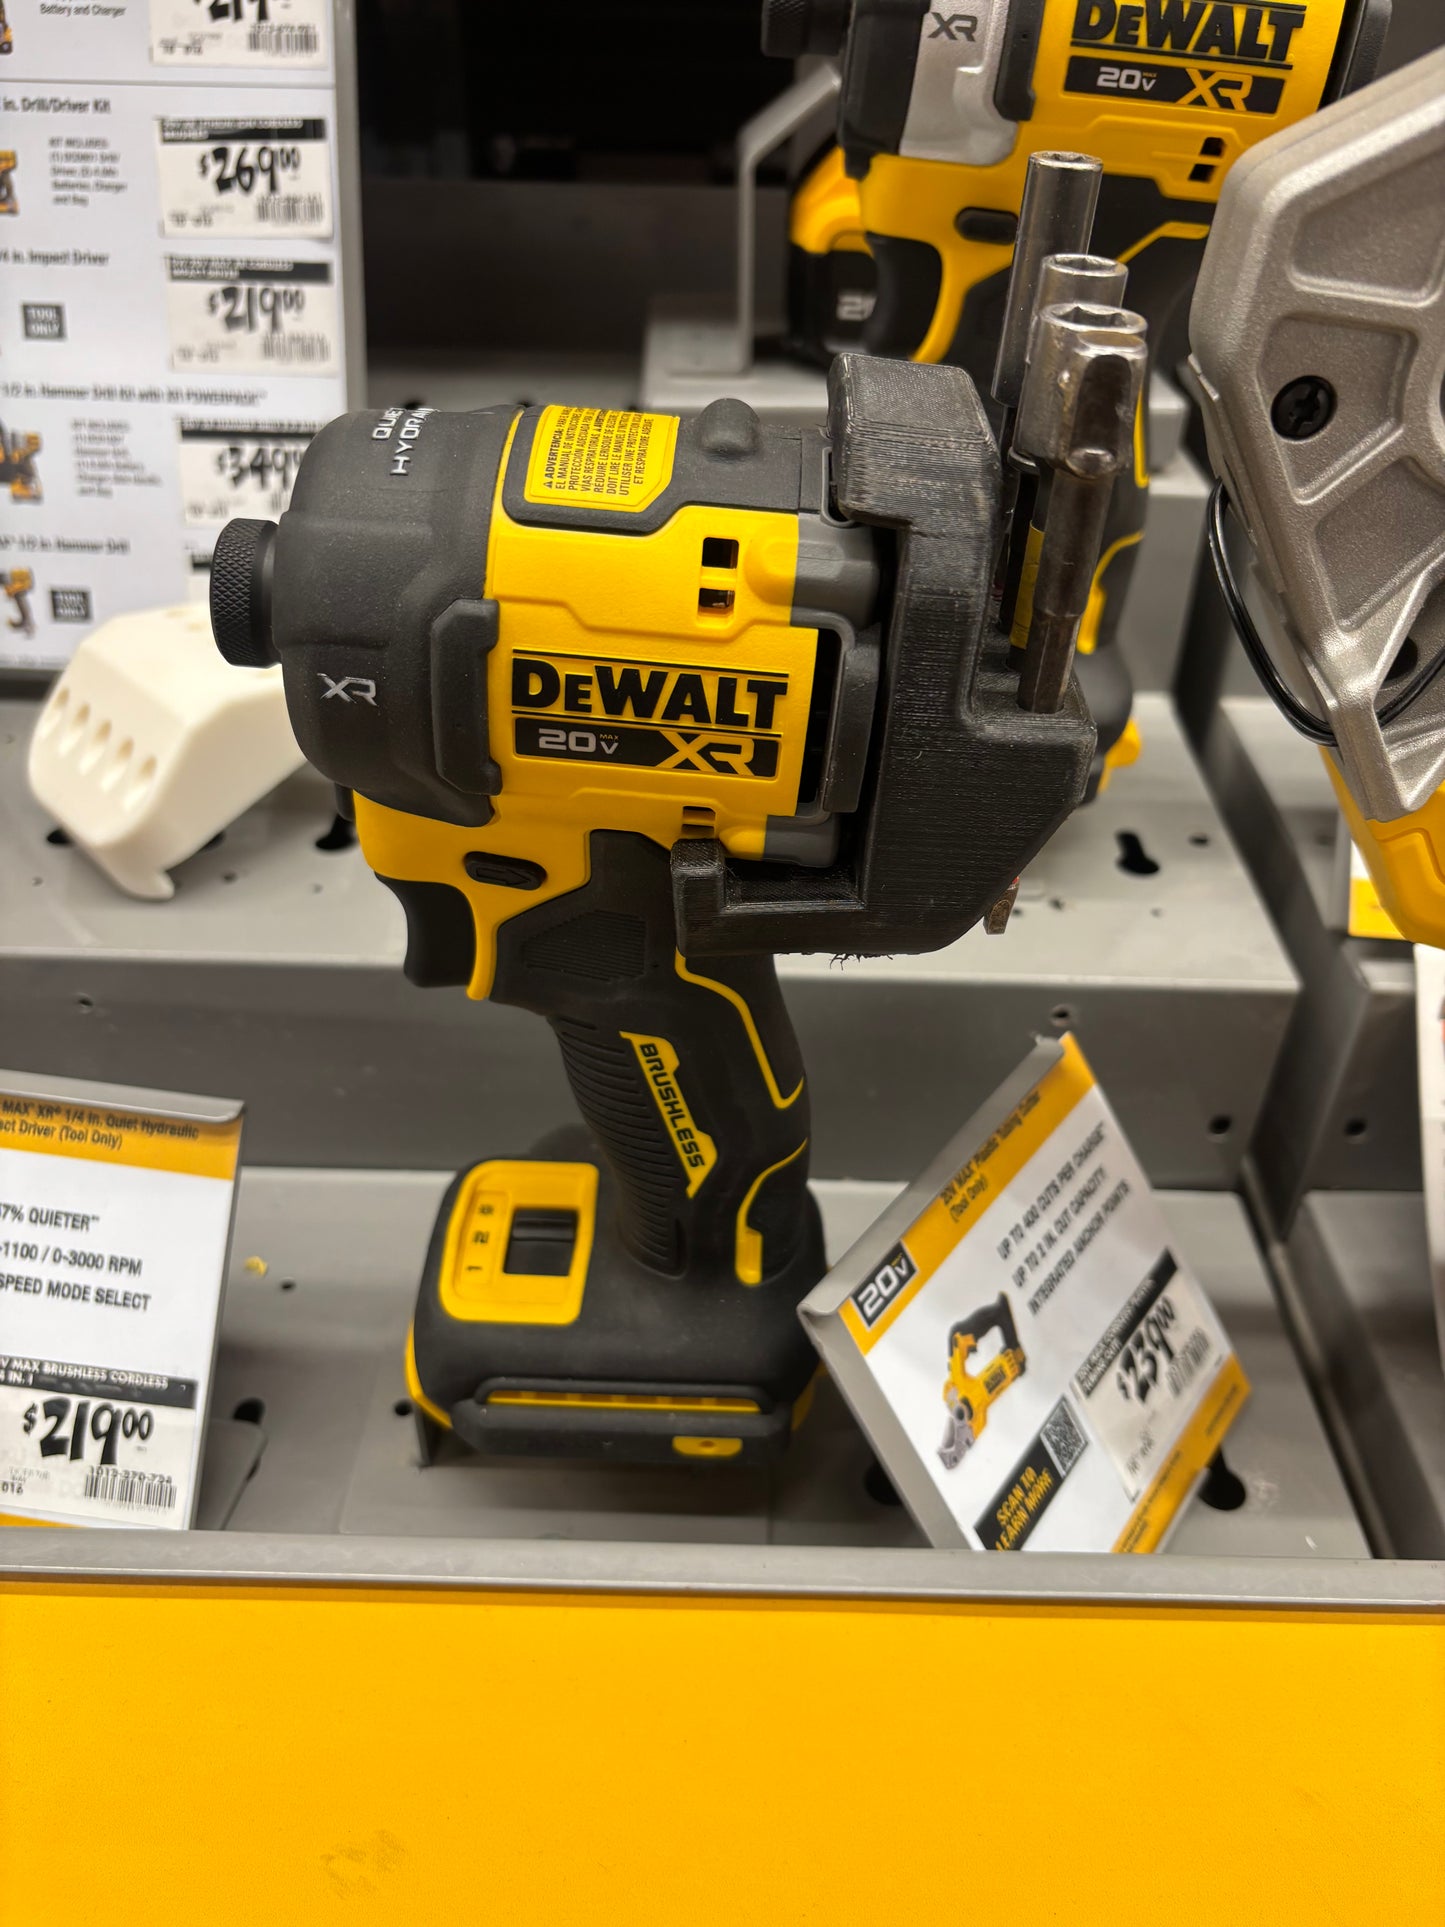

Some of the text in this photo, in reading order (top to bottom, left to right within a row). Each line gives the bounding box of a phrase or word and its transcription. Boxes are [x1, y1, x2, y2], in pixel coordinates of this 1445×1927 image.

[40, 4, 126, 18] Battery and Charger
[927, 12, 978, 42] XR
[1176, 68, 1253, 111] XR
[552, 428, 577, 477] ADVERTENCIA:
[606, 476, 618, 494] DOIT
[618, 463, 633, 496] UTILISER
[633, 475, 644, 485] ET
[317, 672, 378, 707] XR
[654, 730, 756, 777] XR
[640, 1042, 706, 1169] BRUSHLESS
[19, 1119, 57, 1139] Driver
[59, 1124, 89, 1144] (Tool
[91, 1129, 124, 1151] Only)
[105, 1115, 138, 1132] Quiet
[141, 1118, 201, 1142] Hydraulic
[42, 1246, 50, 1263] /
[52, 1247, 105, 1271] 0-3000
[108, 1255, 143, 1277] RPM
[0, 1272, 152, 1313] SPEED MODE SELECT
[11, 1358, 40, 1375] MAX
[43, 1360, 107, 1383] BRUSHLESS
[109, 1369, 169, 1391] CORDLESS
[995, 1463, 1037, 1526] SCAN TO
[1023, 1465, 1053, 1513] MORE
